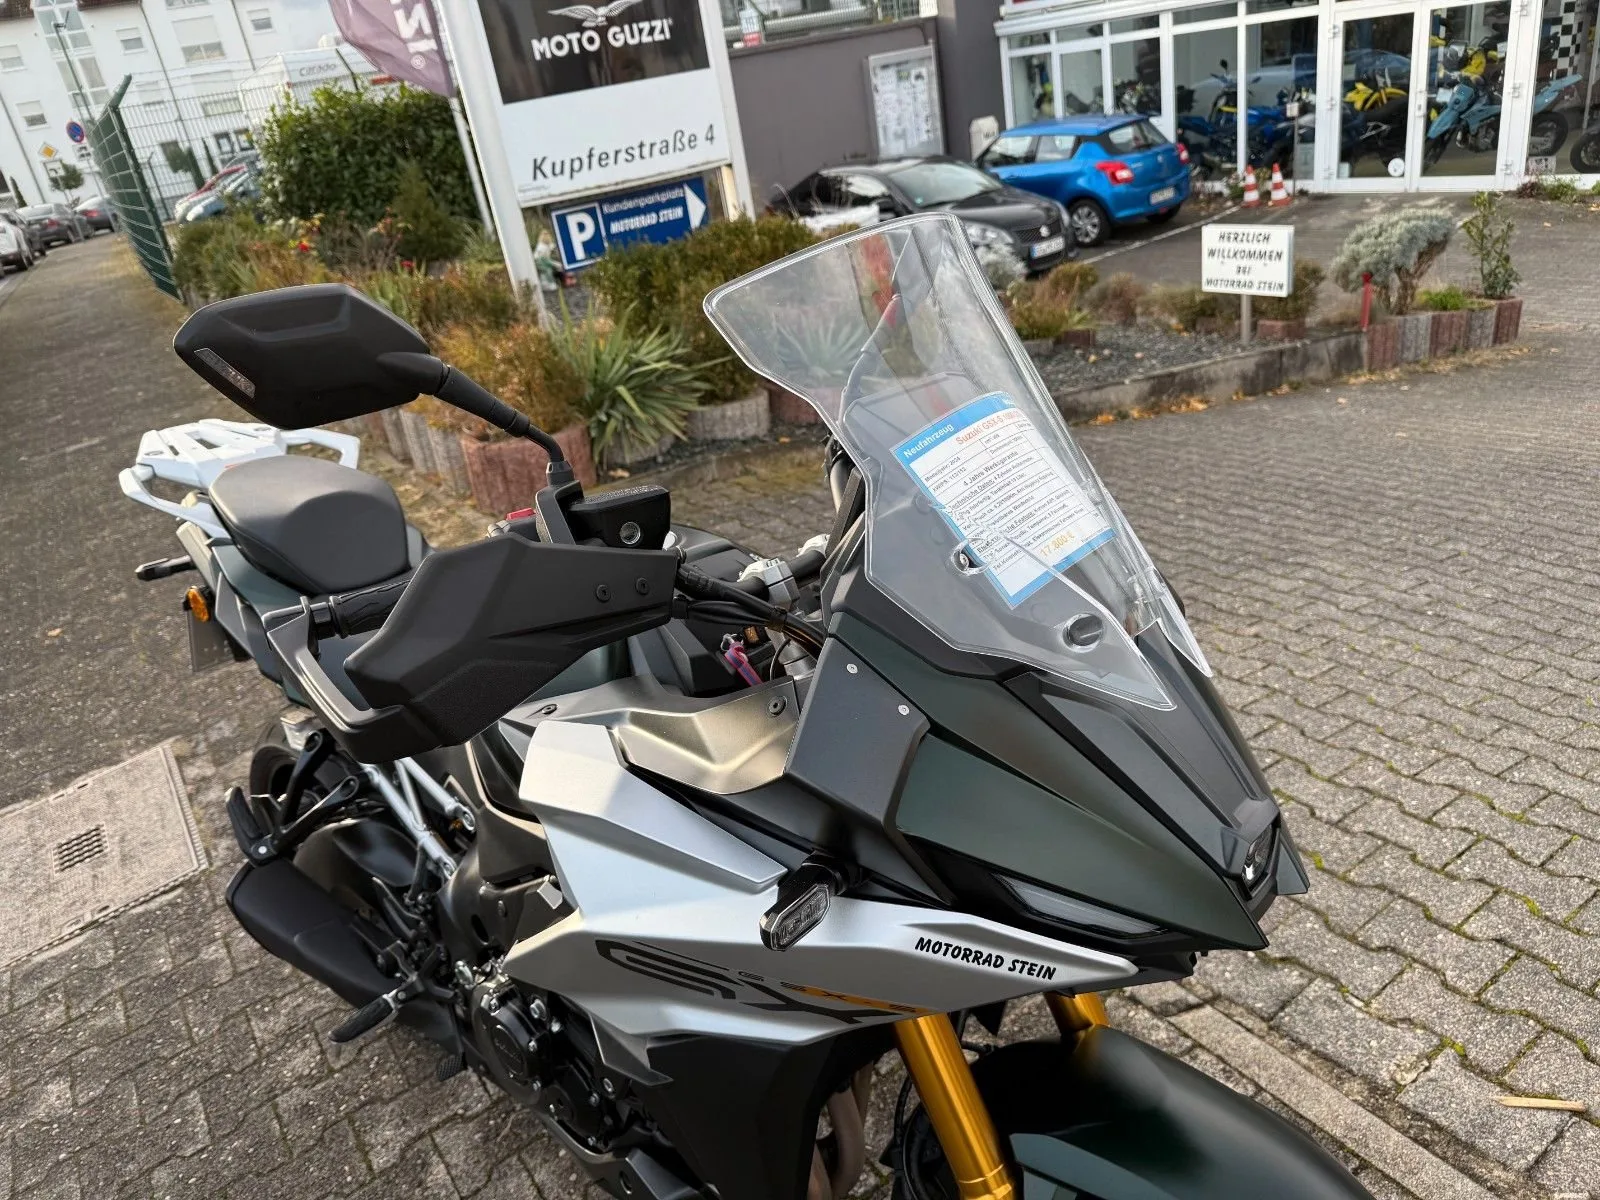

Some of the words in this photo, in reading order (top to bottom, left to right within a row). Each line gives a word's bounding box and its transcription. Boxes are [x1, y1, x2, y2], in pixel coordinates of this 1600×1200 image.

[531, 30, 601, 60] MOTO
[607, 18, 671, 48] GUZZI
[532, 129, 697, 180] Kupferstraße
[705, 124, 716, 146] 4
[566, 212, 596, 261] P
[1218, 231, 1271, 244] HERZLICH
[1207, 247, 1283, 261] WILLKOMMEN
[1236, 265, 1252, 275] BEI
[1205, 278, 1254, 289] MOTORRAD
[1256, 279, 1284, 291] STEIN
[903, 424, 954, 458] Neufahrzeug
[955, 425, 981, 445] Suzuki
[915, 937, 1004, 968] MOTORRAD
[1008, 959, 1056, 980] STEIN
